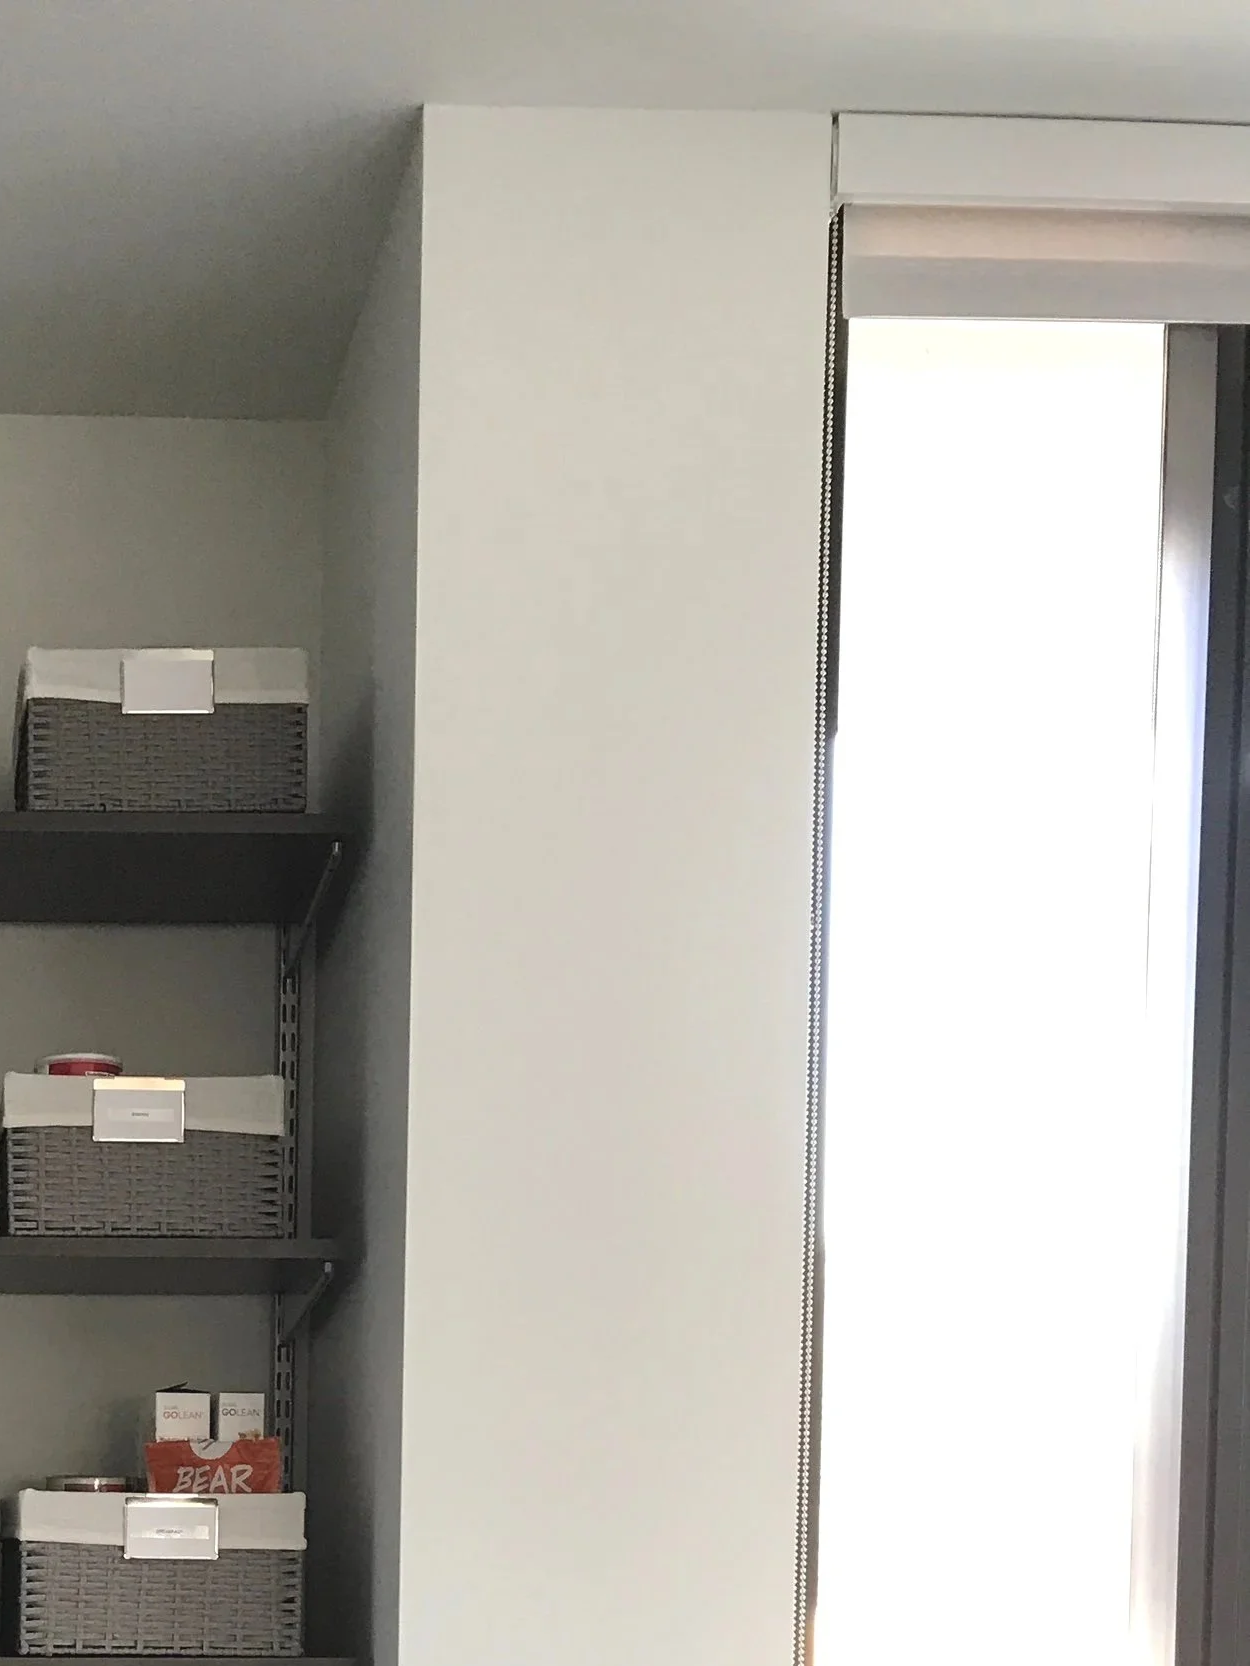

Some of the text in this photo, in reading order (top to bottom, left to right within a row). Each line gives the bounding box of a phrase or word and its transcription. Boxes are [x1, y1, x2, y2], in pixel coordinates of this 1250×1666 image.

[163, 1411, 202, 1420] GOLEAN
[221, 1408, 260, 1417] GOLEAN
[172, 1464, 253, 1493] BEAR
